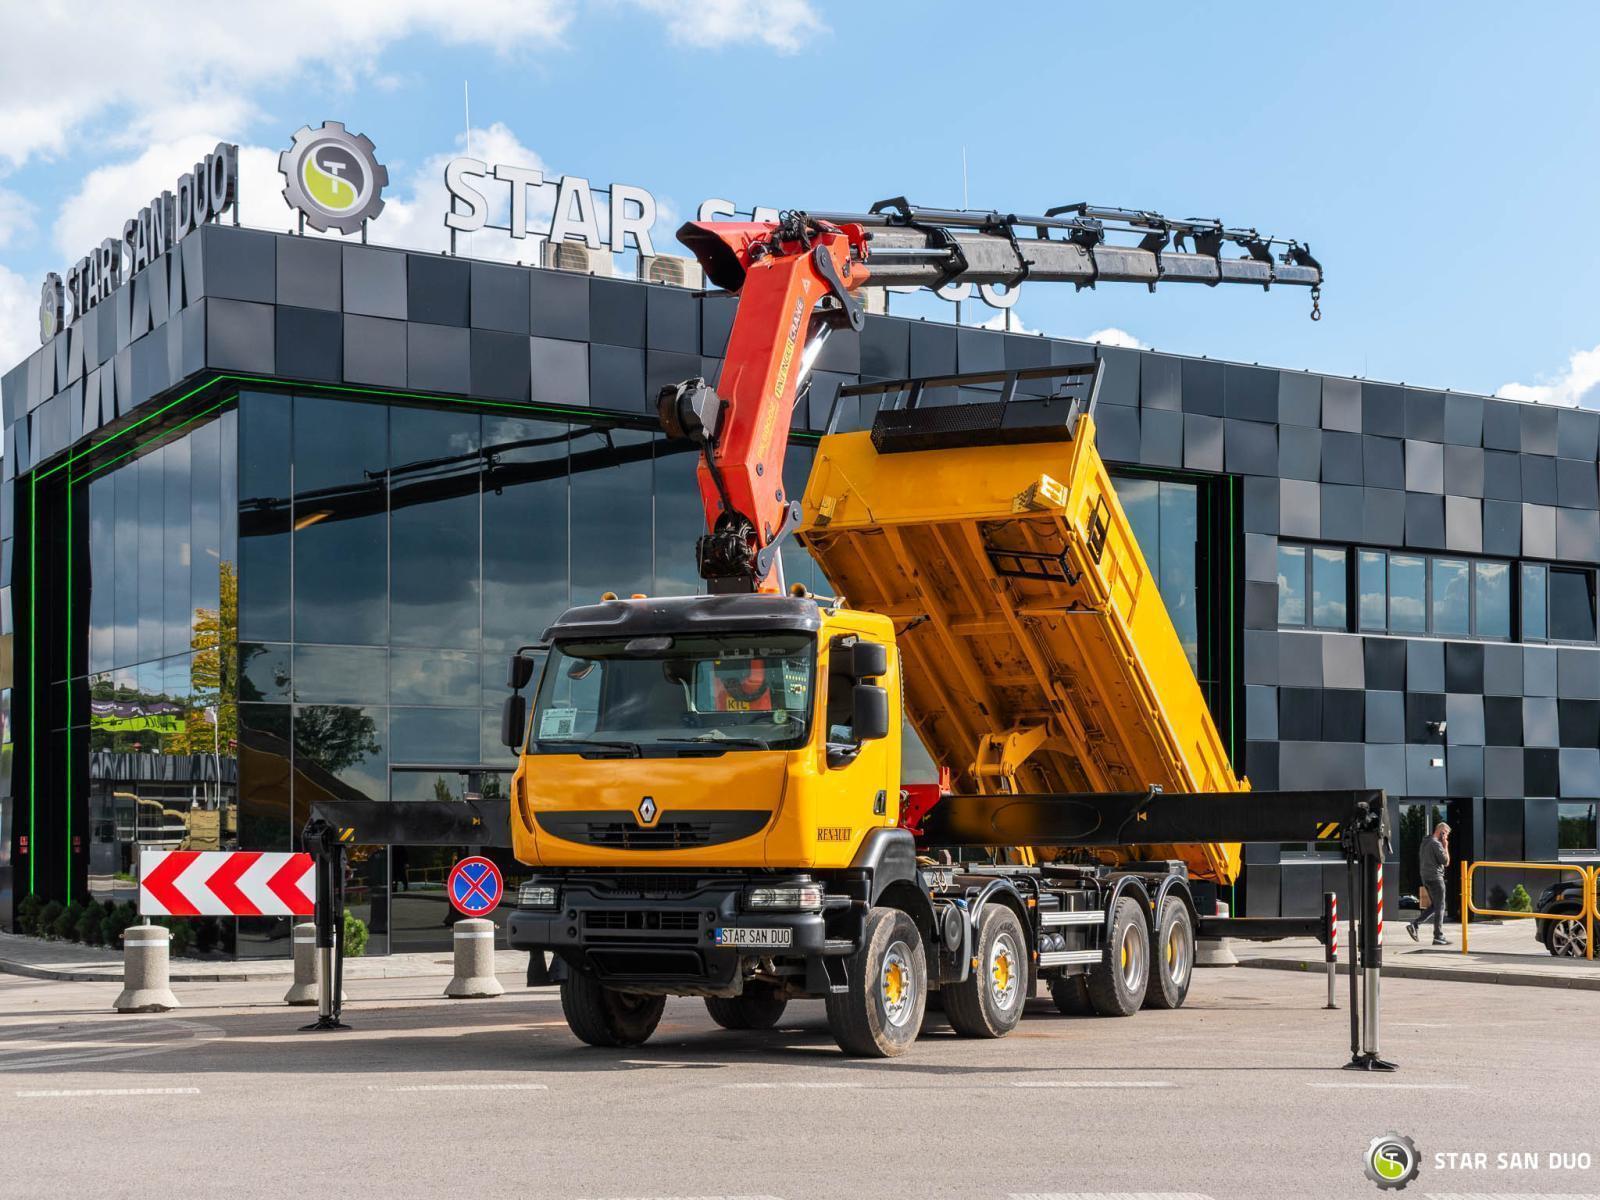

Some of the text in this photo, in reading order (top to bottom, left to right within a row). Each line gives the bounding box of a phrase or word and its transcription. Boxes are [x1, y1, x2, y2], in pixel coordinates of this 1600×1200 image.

[66, 142, 232, 327] STAR SAN DUO
[444, 157, 657, 258] STAR
[817, 827, 852, 841] RENAULT
[722, 929, 790, 944] STAR SAN DUO
